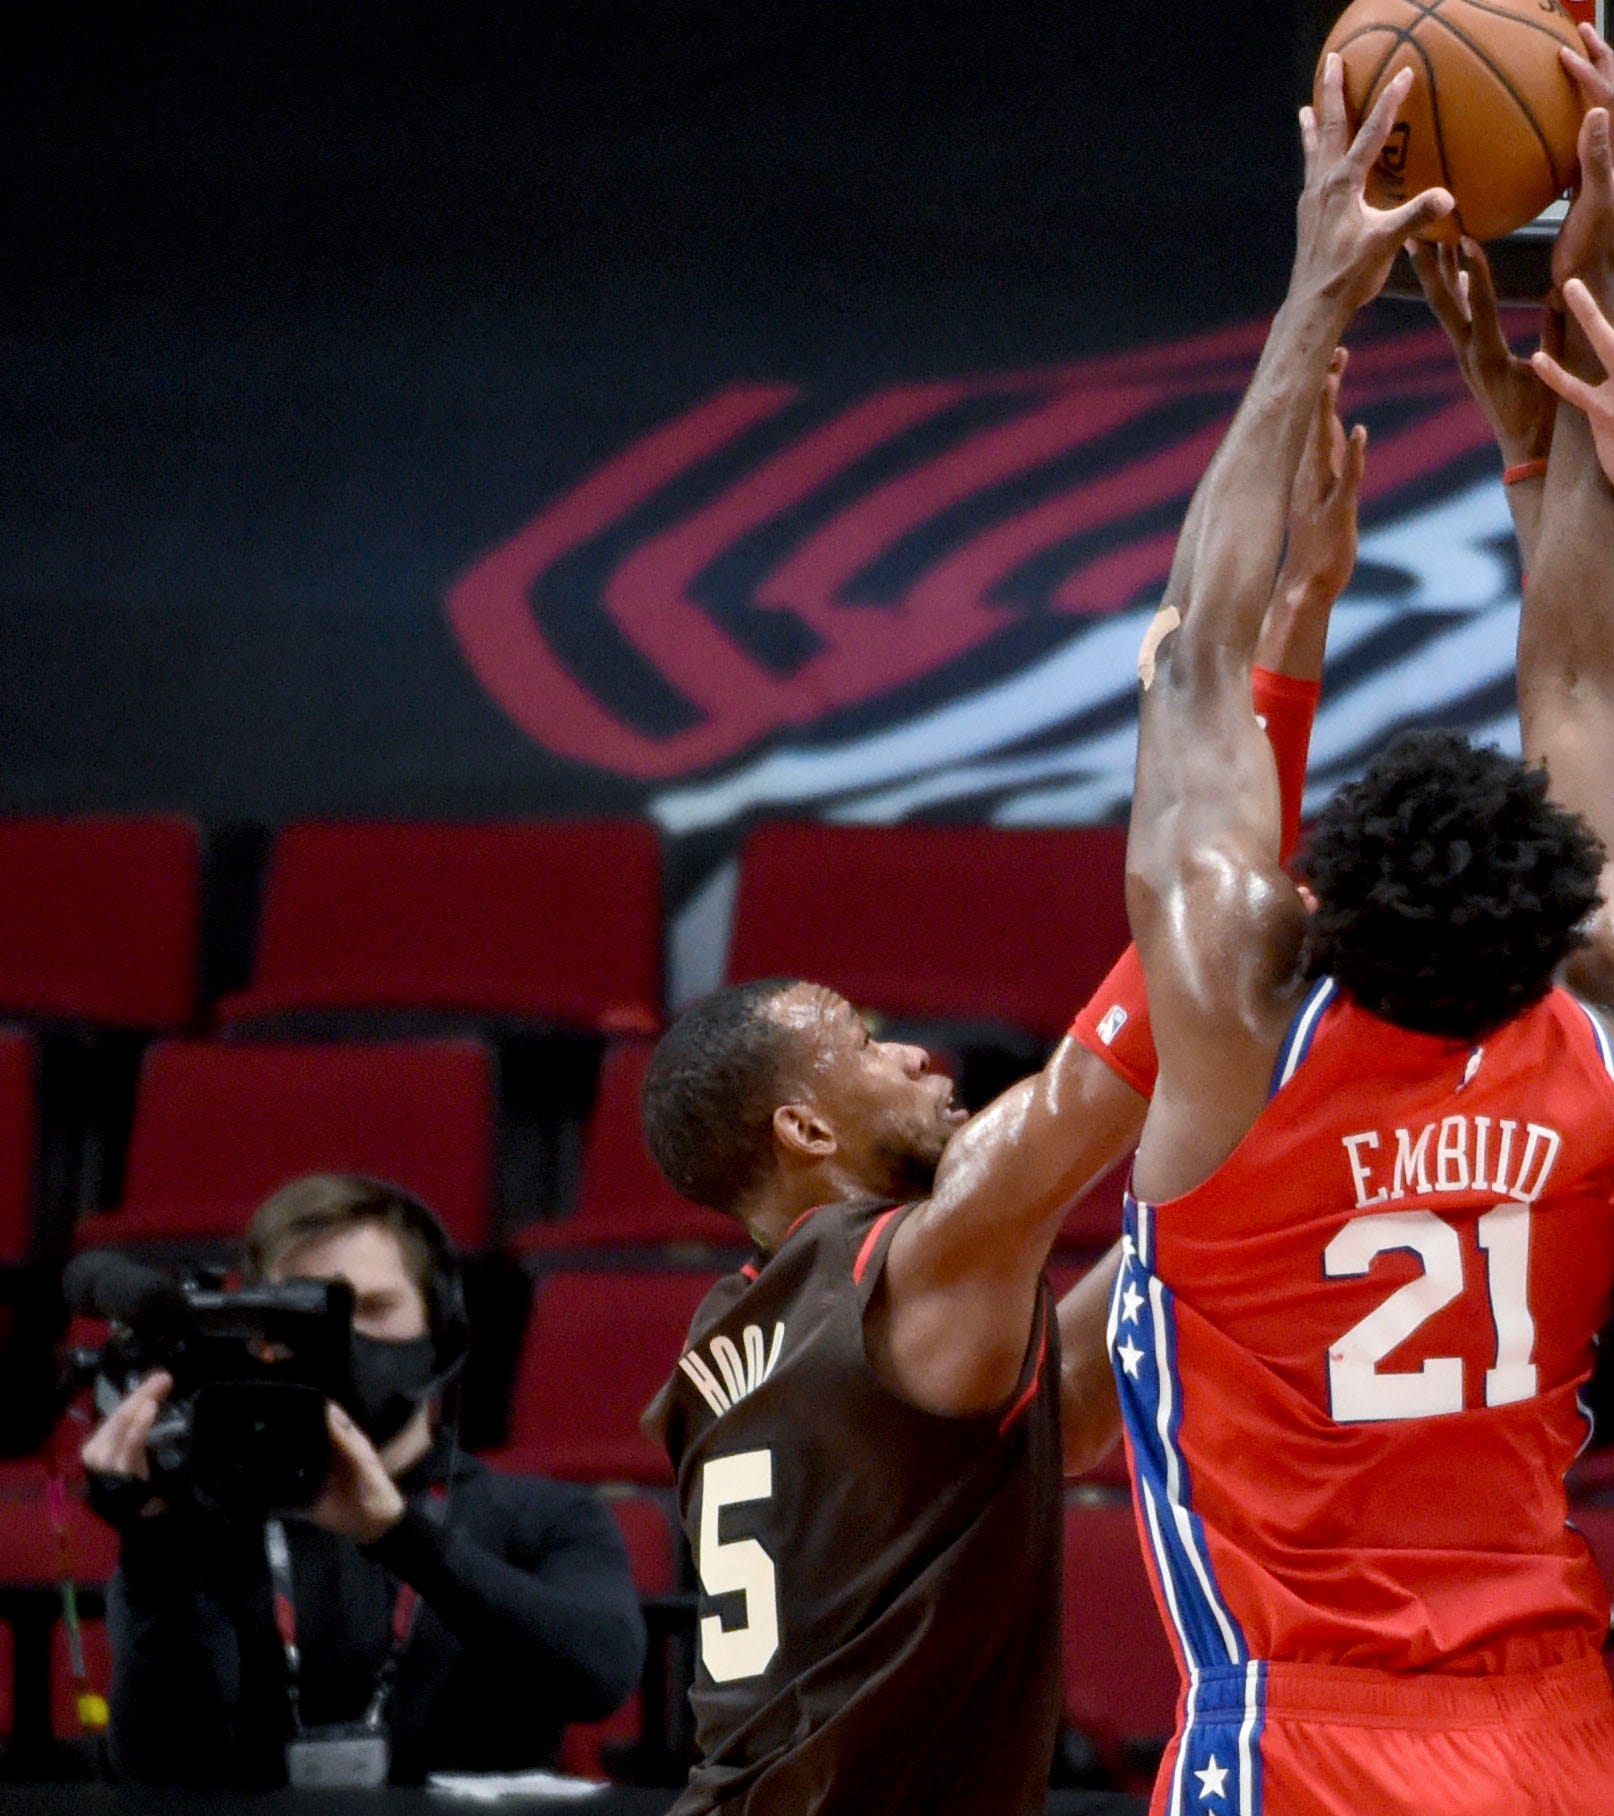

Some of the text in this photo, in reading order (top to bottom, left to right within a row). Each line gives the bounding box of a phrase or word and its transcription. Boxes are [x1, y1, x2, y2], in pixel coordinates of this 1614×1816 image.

[1342, 1115, 1562, 1208] EMBIID
[1323, 1202, 1538, 1422] 21
[700, 1448, 780, 1683] 5
